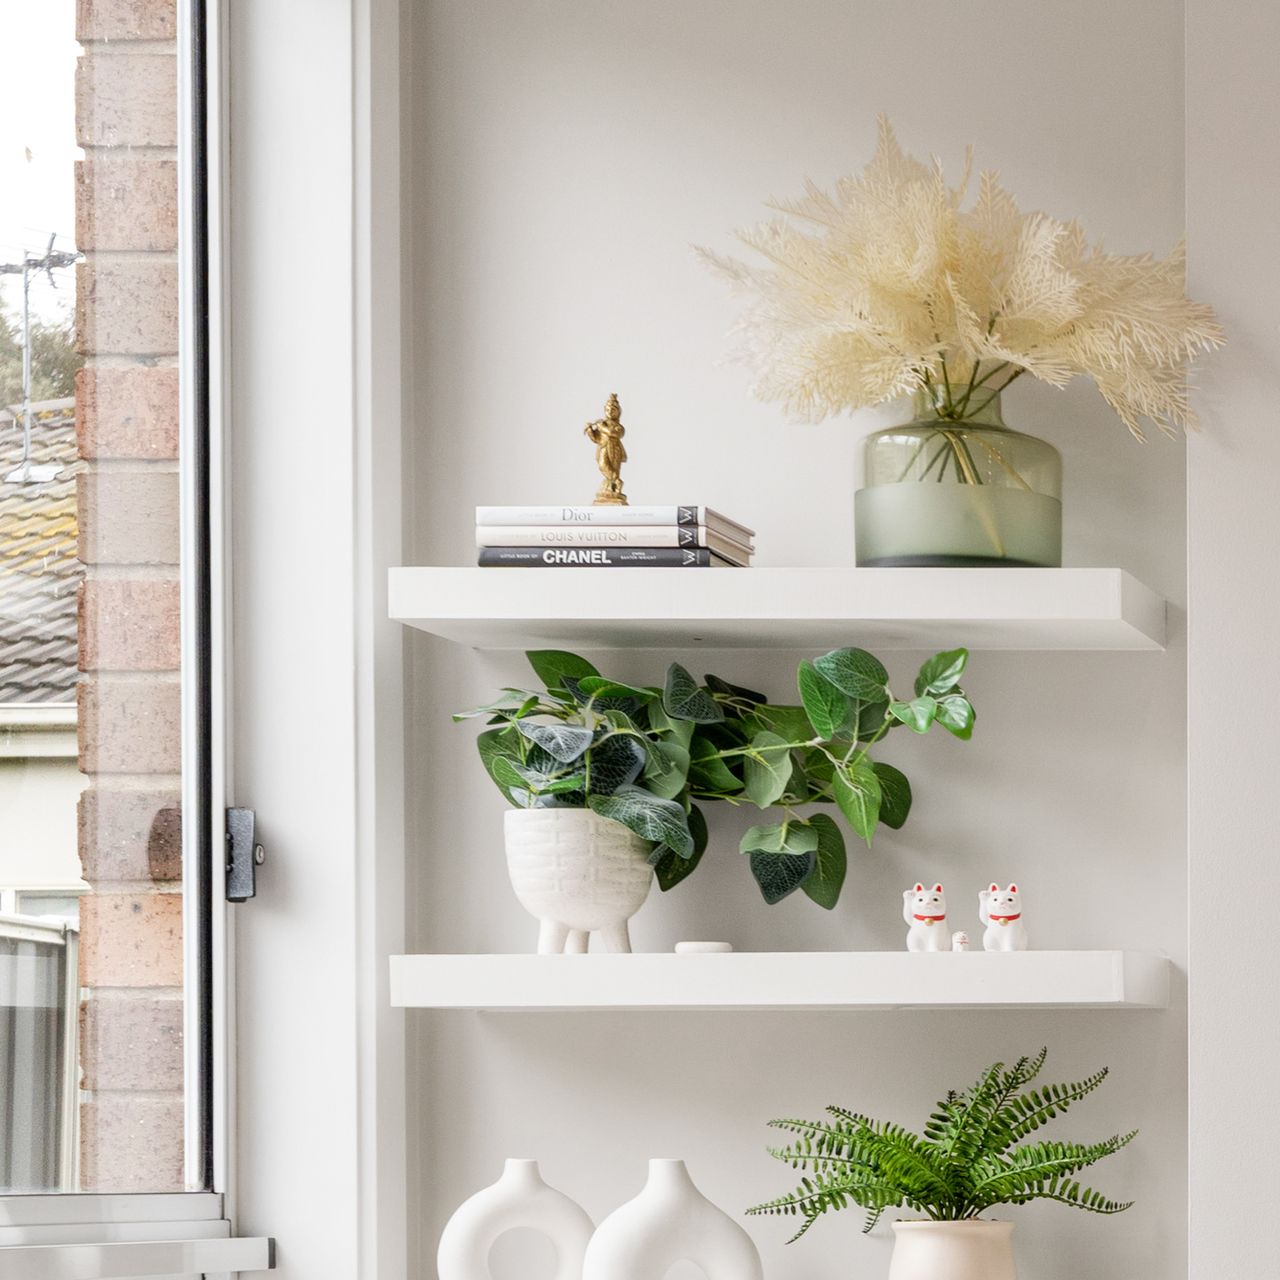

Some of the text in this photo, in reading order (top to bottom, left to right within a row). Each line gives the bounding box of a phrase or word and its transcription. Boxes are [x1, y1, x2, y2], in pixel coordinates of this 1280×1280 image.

[561, 507, 594, 521] Dior
[541, 532, 574, 541] LOUIS
[577, 532, 628, 541] VUITTON
[542, 549, 612, 564] CHANEL
